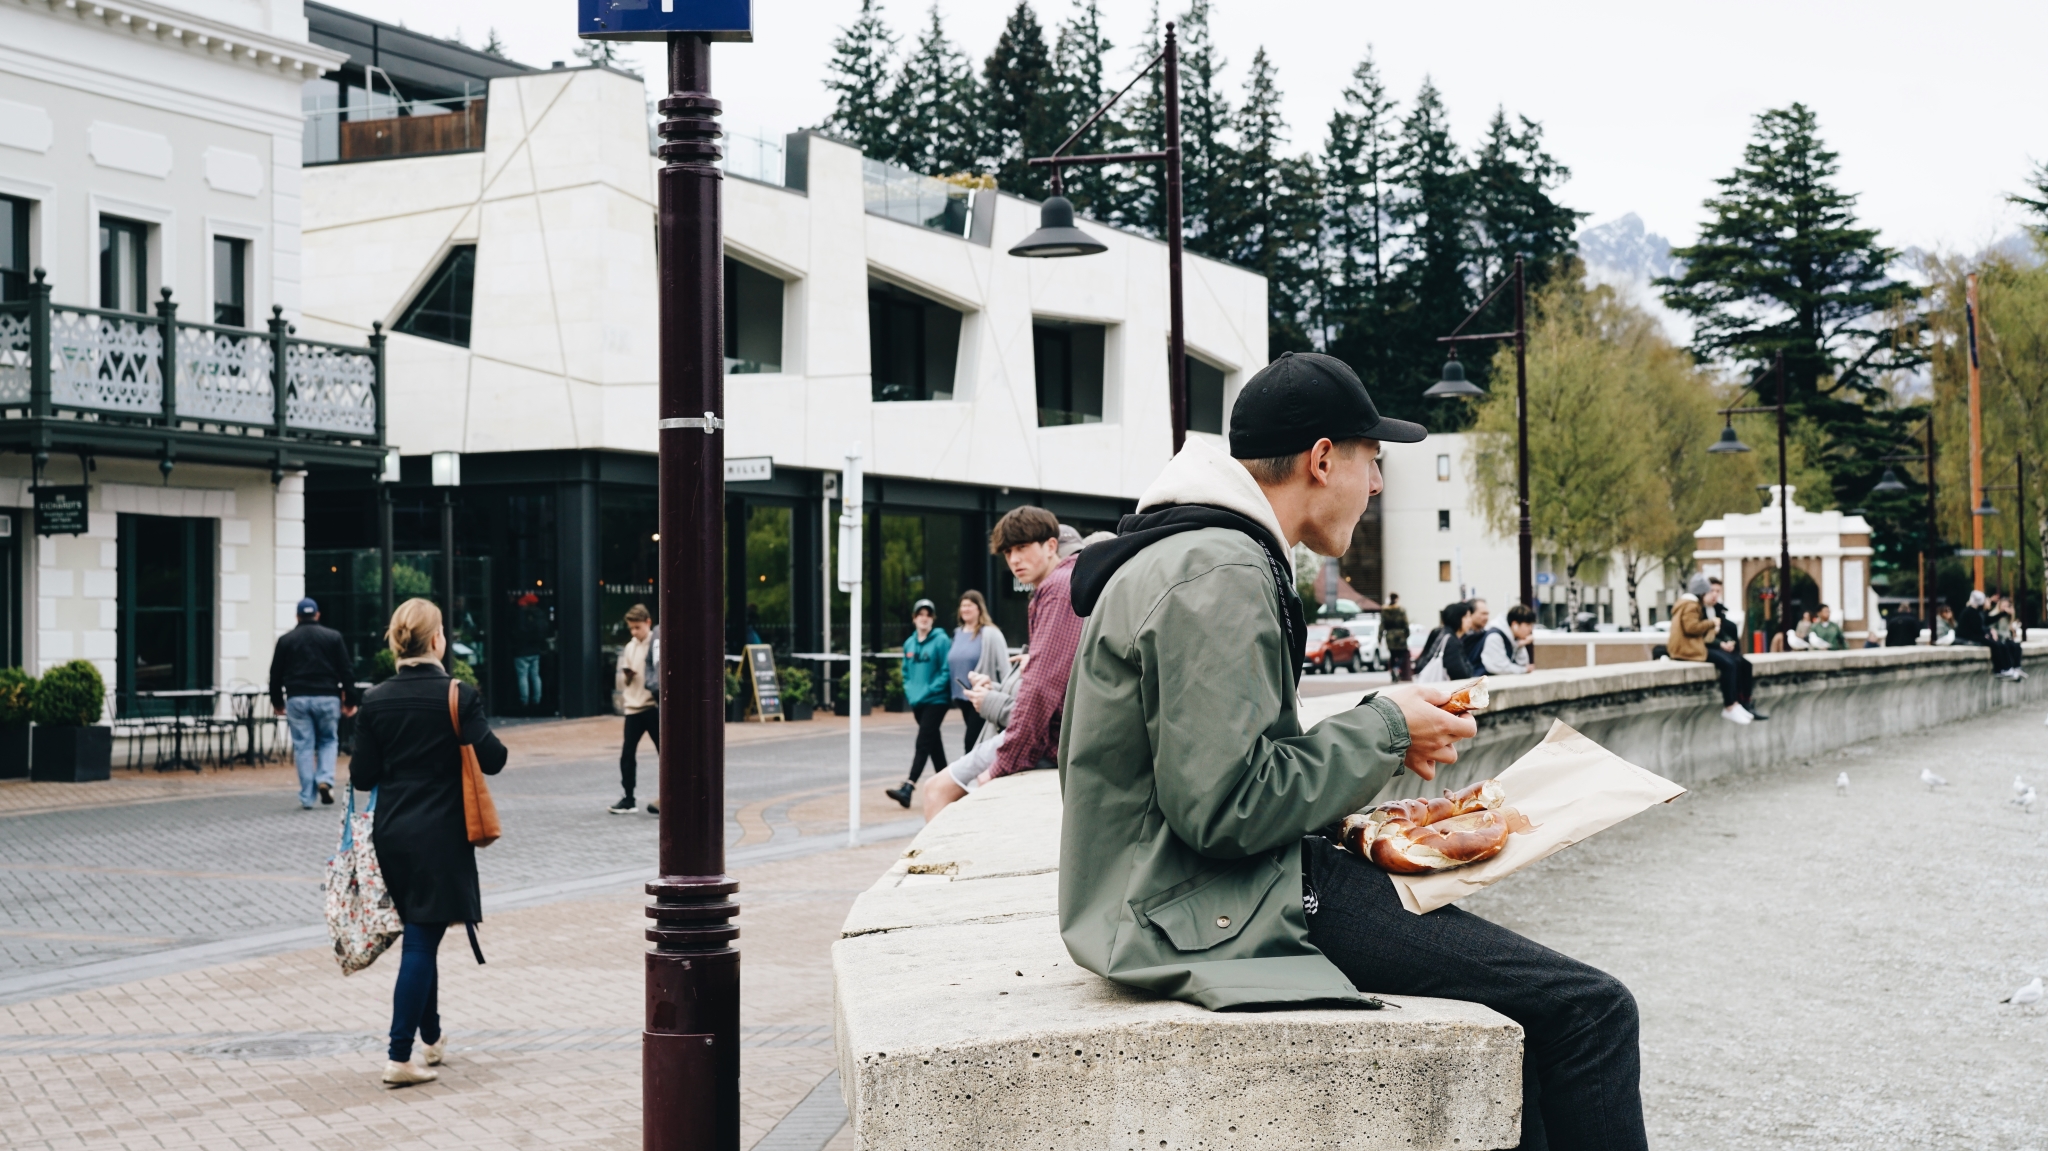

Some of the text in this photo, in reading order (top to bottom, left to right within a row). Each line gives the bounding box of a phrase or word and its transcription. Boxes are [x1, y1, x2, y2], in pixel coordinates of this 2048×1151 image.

[728, 464, 766, 475] RILLE
[606, 584, 654, 595] THE GRILLE
